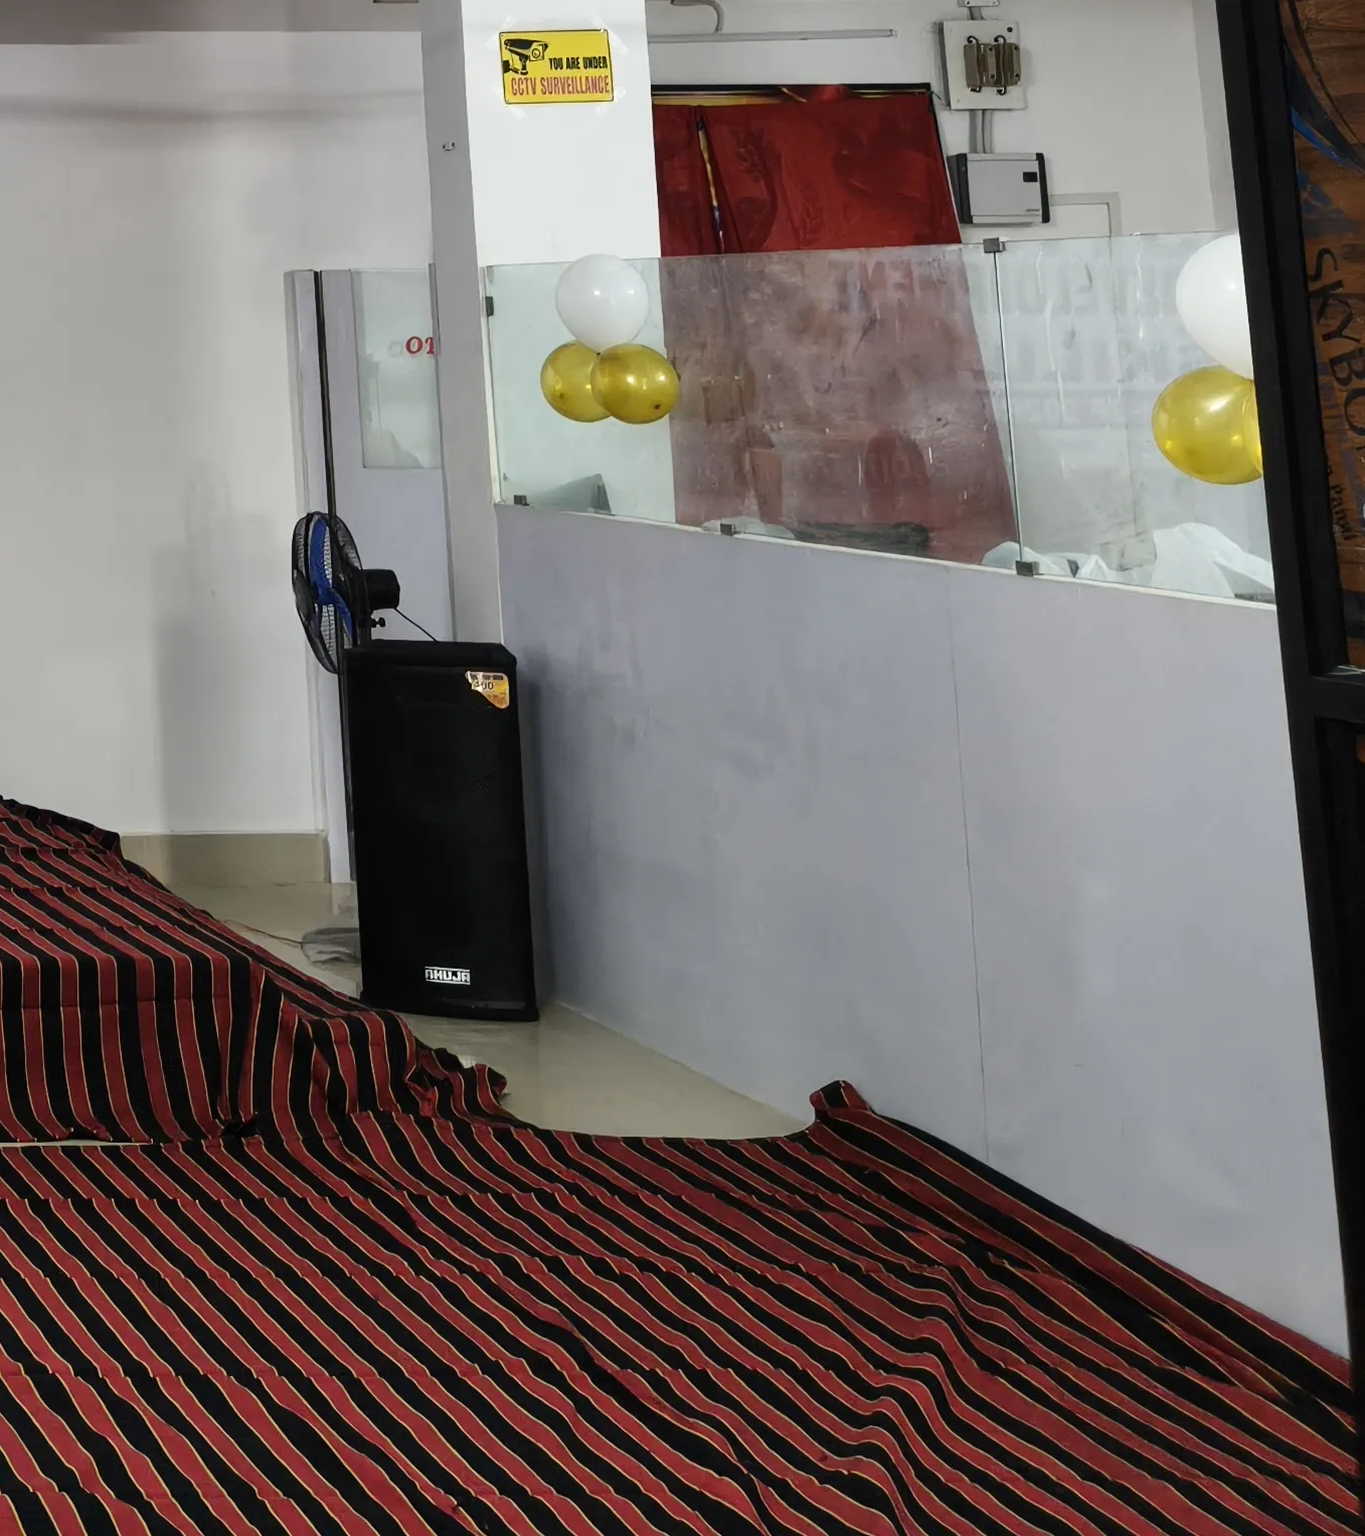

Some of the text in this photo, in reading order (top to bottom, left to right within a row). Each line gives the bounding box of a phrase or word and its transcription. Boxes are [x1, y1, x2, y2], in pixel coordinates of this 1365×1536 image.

[548, 55, 608, 70] YOU ARE UNDER
[511, 76, 609, 96] CCTV SURVEILLANCE
[425, 969, 471, 983] AHUJA
